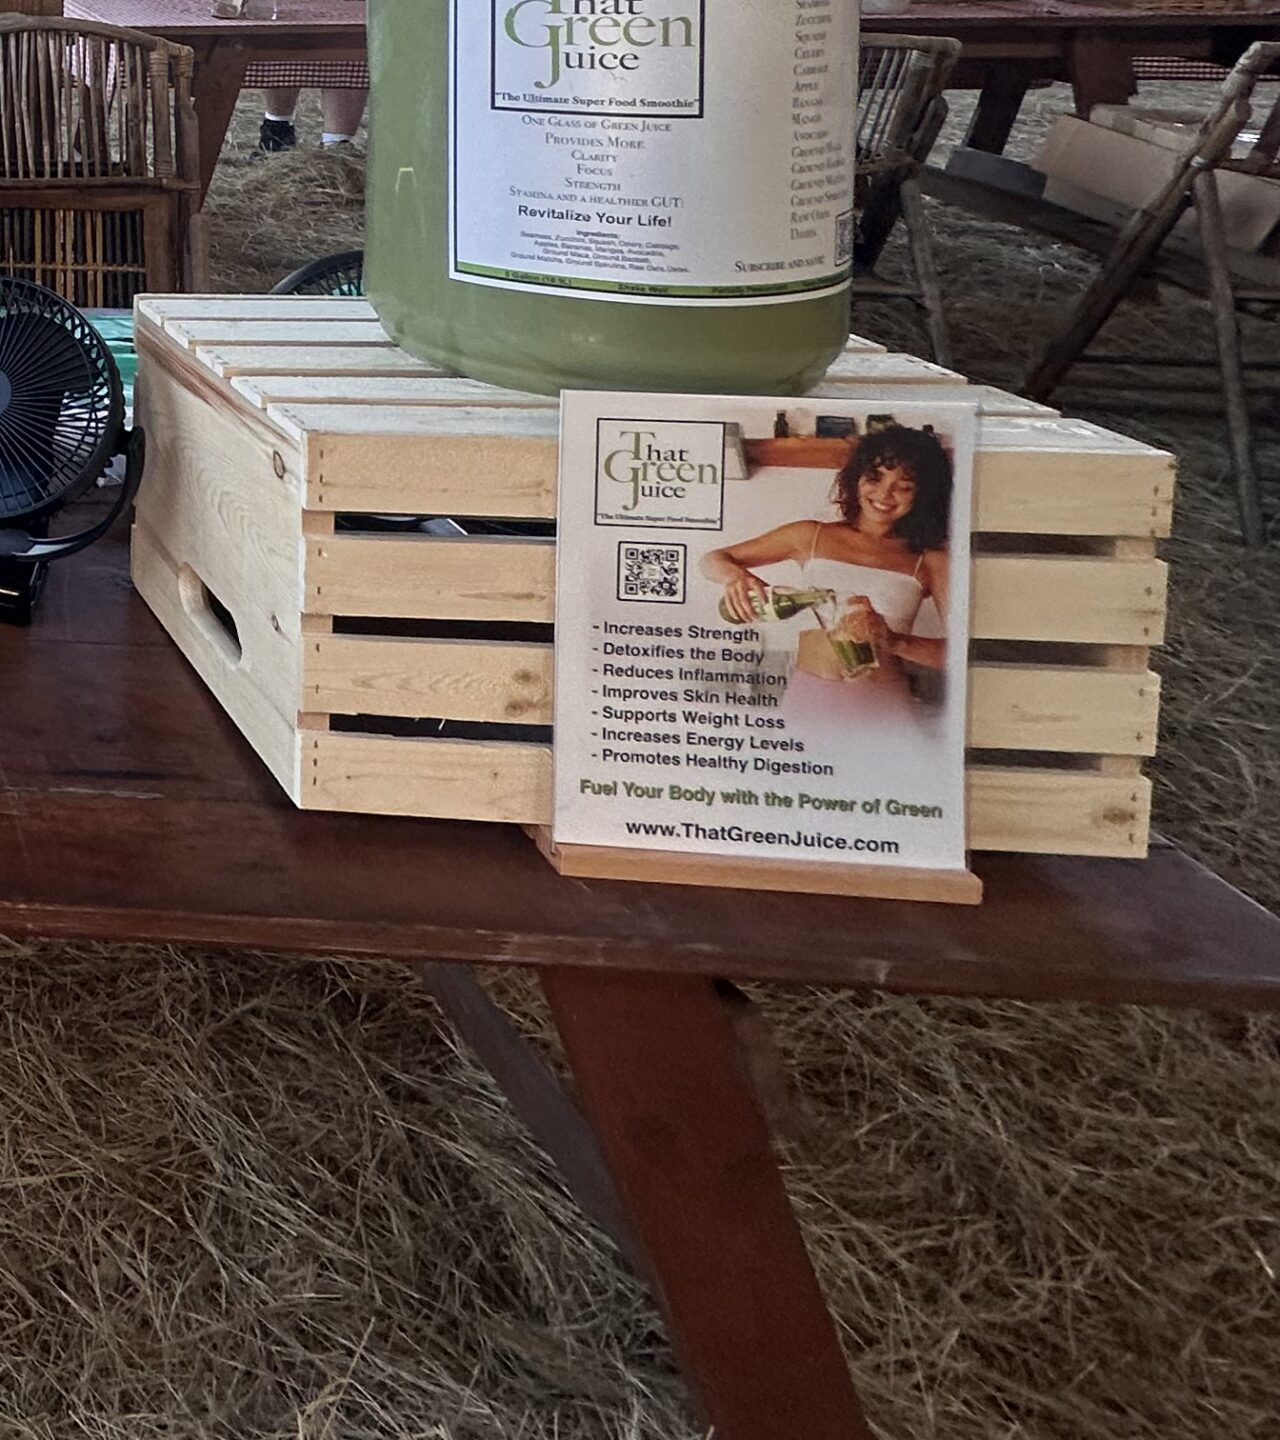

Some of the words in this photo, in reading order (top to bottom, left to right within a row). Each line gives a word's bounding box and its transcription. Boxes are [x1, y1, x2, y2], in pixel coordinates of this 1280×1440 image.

[504, 0, 695, 48] Green
[534, 24, 640, 89] Juice
[572, 95, 605, 108] Super
[609, 97, 636, 107] Food
[519, 204, 591, 223] Revitalize
[596, 211, 632, 225] Your
[638, 214, 671, 228] Life!
[621, 430, 689, 463] That
[604, 450, 717, 485] Green
[623, 469, 686, 511] Juice
[604, 620, 682, 638] Increases
[688, 624, 759, 645] Strength
[604, 642, 684, 660] Detoxifies
[690, 646, 716, 661] the
[722, 648, 765, 667] Body
[604, 663, 673, 680] Reduces
[679, 667, 787, 689] Inflammation
[603, 684, 678, 702] Improves
[683, 688, 719, 704] Skin
[726, 689, 777, 708] Health
[603, 705, 676, 725] Supports
[682, 710, 739, 729] Weight
[745, 713, 785, 730] Loss
[603, 727, 680, 745] Increases
[687, 731, 744, 752] Energy
[750, 735, 804, 753] Levels
[603, 748, 680, 767] Promotes
[686, 753, 748, 774] Healthy
[754, 757, 833, 776] Digestion
[580, 778, 617, 797] Fuel
[622, 781, 664, 800] Your
[669, 784, 716, 807] Body
[721, 788, 759, 806] with
[764, 791, 793, 809] the
[799, 792, 857, 813] Power
[861, 798, 881, 815] of
[885, 798, 943, 819] Green
[626, 822, 899, 854] www.ThatGreenJuice.com
